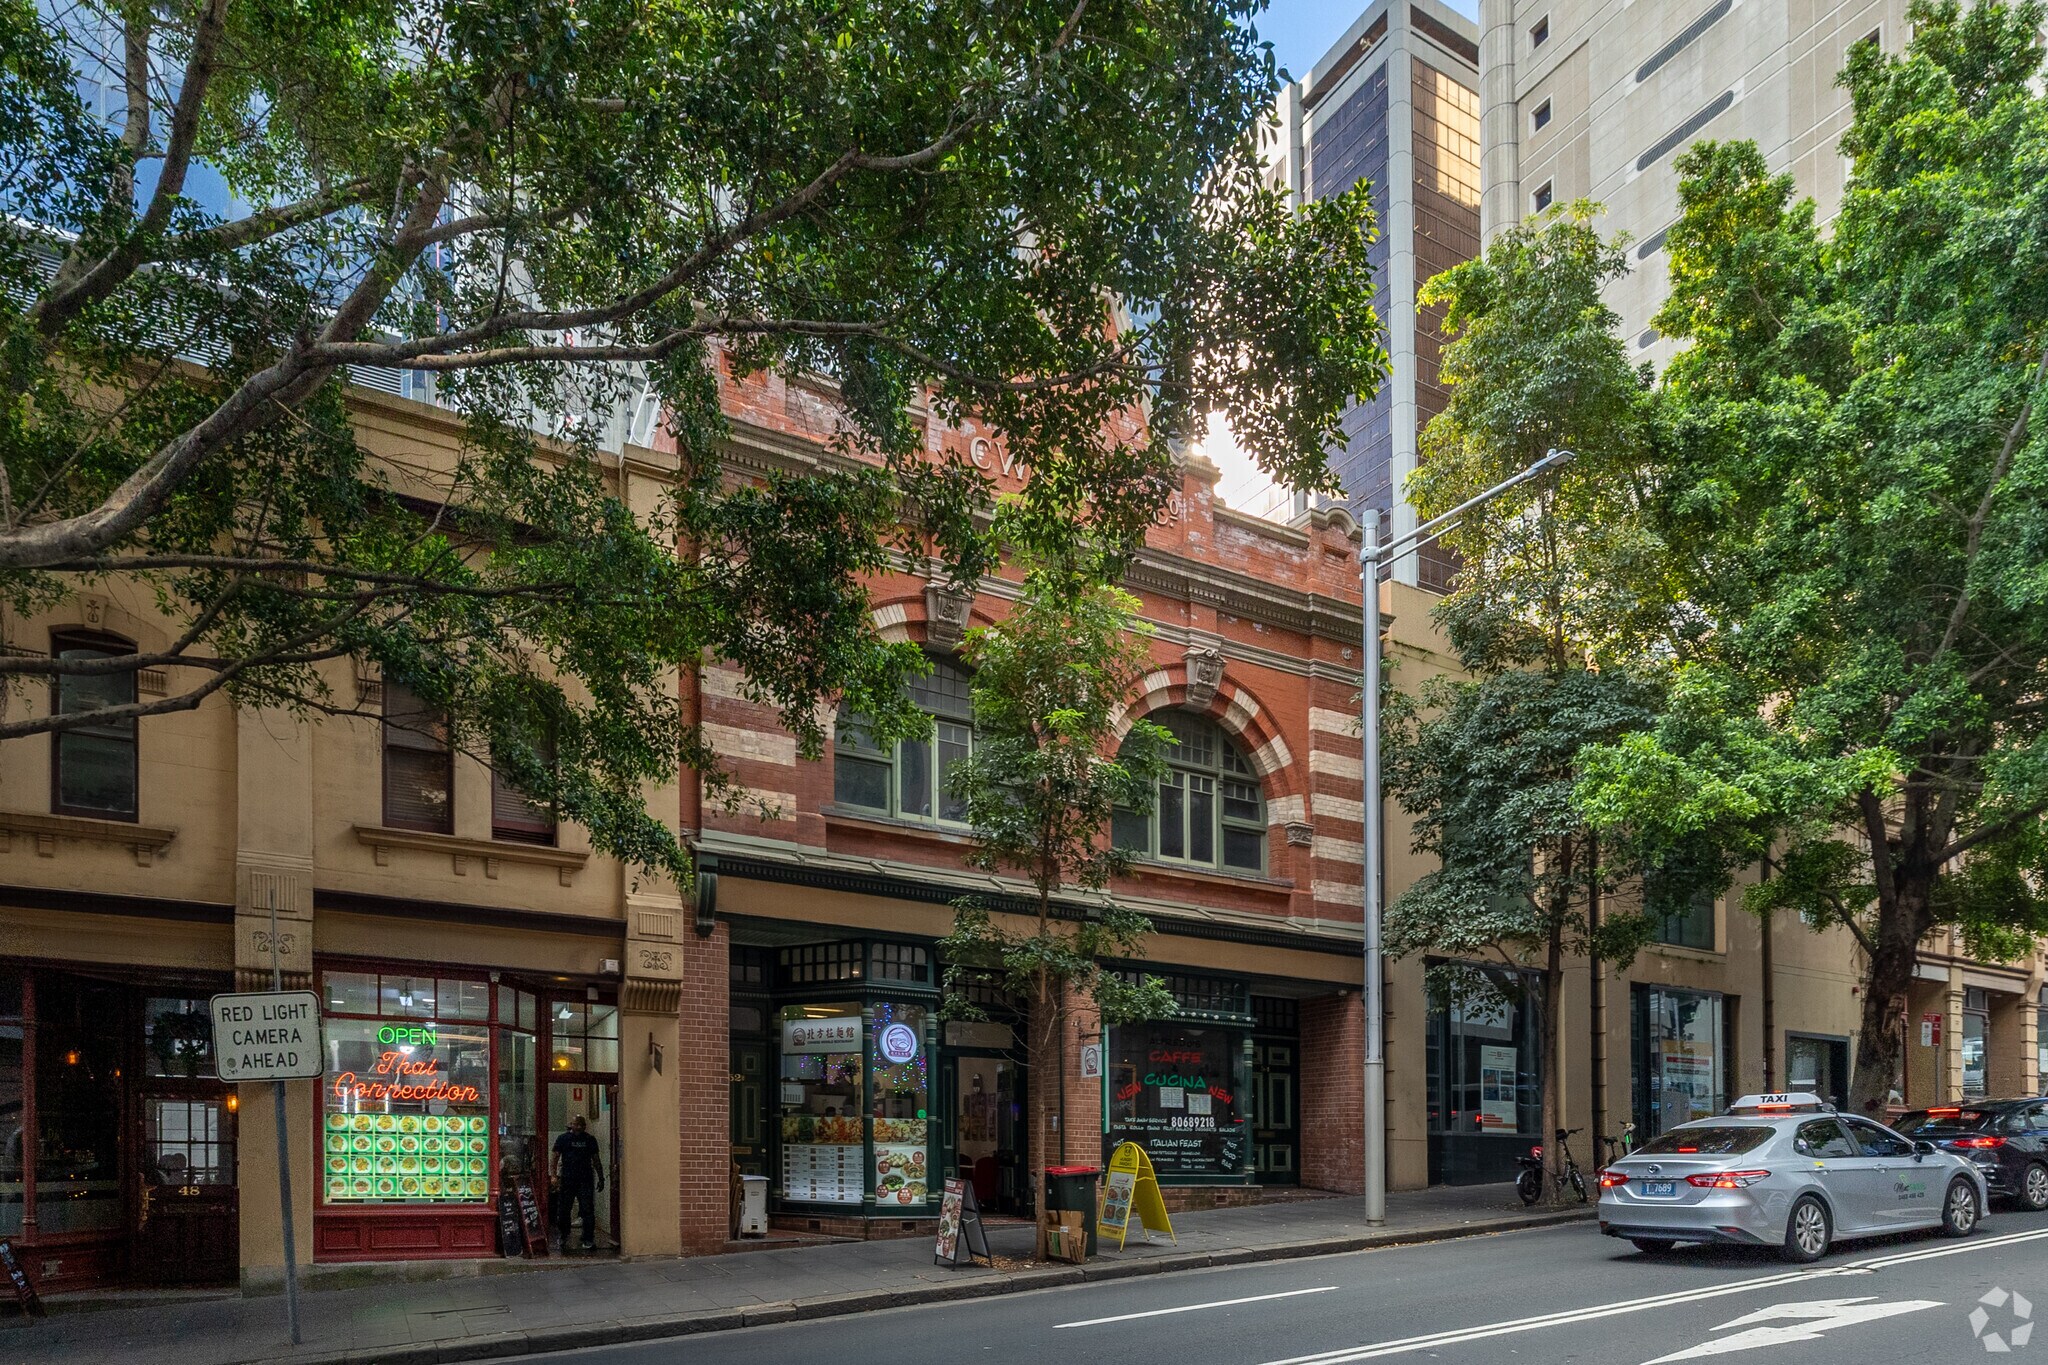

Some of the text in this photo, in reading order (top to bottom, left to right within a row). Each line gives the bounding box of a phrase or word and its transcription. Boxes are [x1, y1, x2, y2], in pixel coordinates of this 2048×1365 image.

[221, 1004, 308, 1022] RED LIGHT
[233, 1028, 302, 1046] CAMERA
[378, 1026, 437, 1045] OPEN
[242, 1052, 298, 1069] AHEAD
[377, 1051, 438, 1076] Thai
[335, 1072, 479, 1100] Connection
[1144, 1073, 1207, 1089] CUCINA
[1207, 1085, 1233, 1104] NEW
[1760, 1095, 1787, 1103] TAXI
[1171, 1116, 1215, 1128] 80689218
[1112, 1138, 1125, 1148] HOT
[1150, 1139, 1203, 1148] ITALIAN FEAST
[1226, 1140, 1238, 1150] HOT
[1222, 1148, 1236, 1160] FOOD
[178, 1186, 200, 1196] 48
[1645, 1183, 1672, 1193] T 7689
